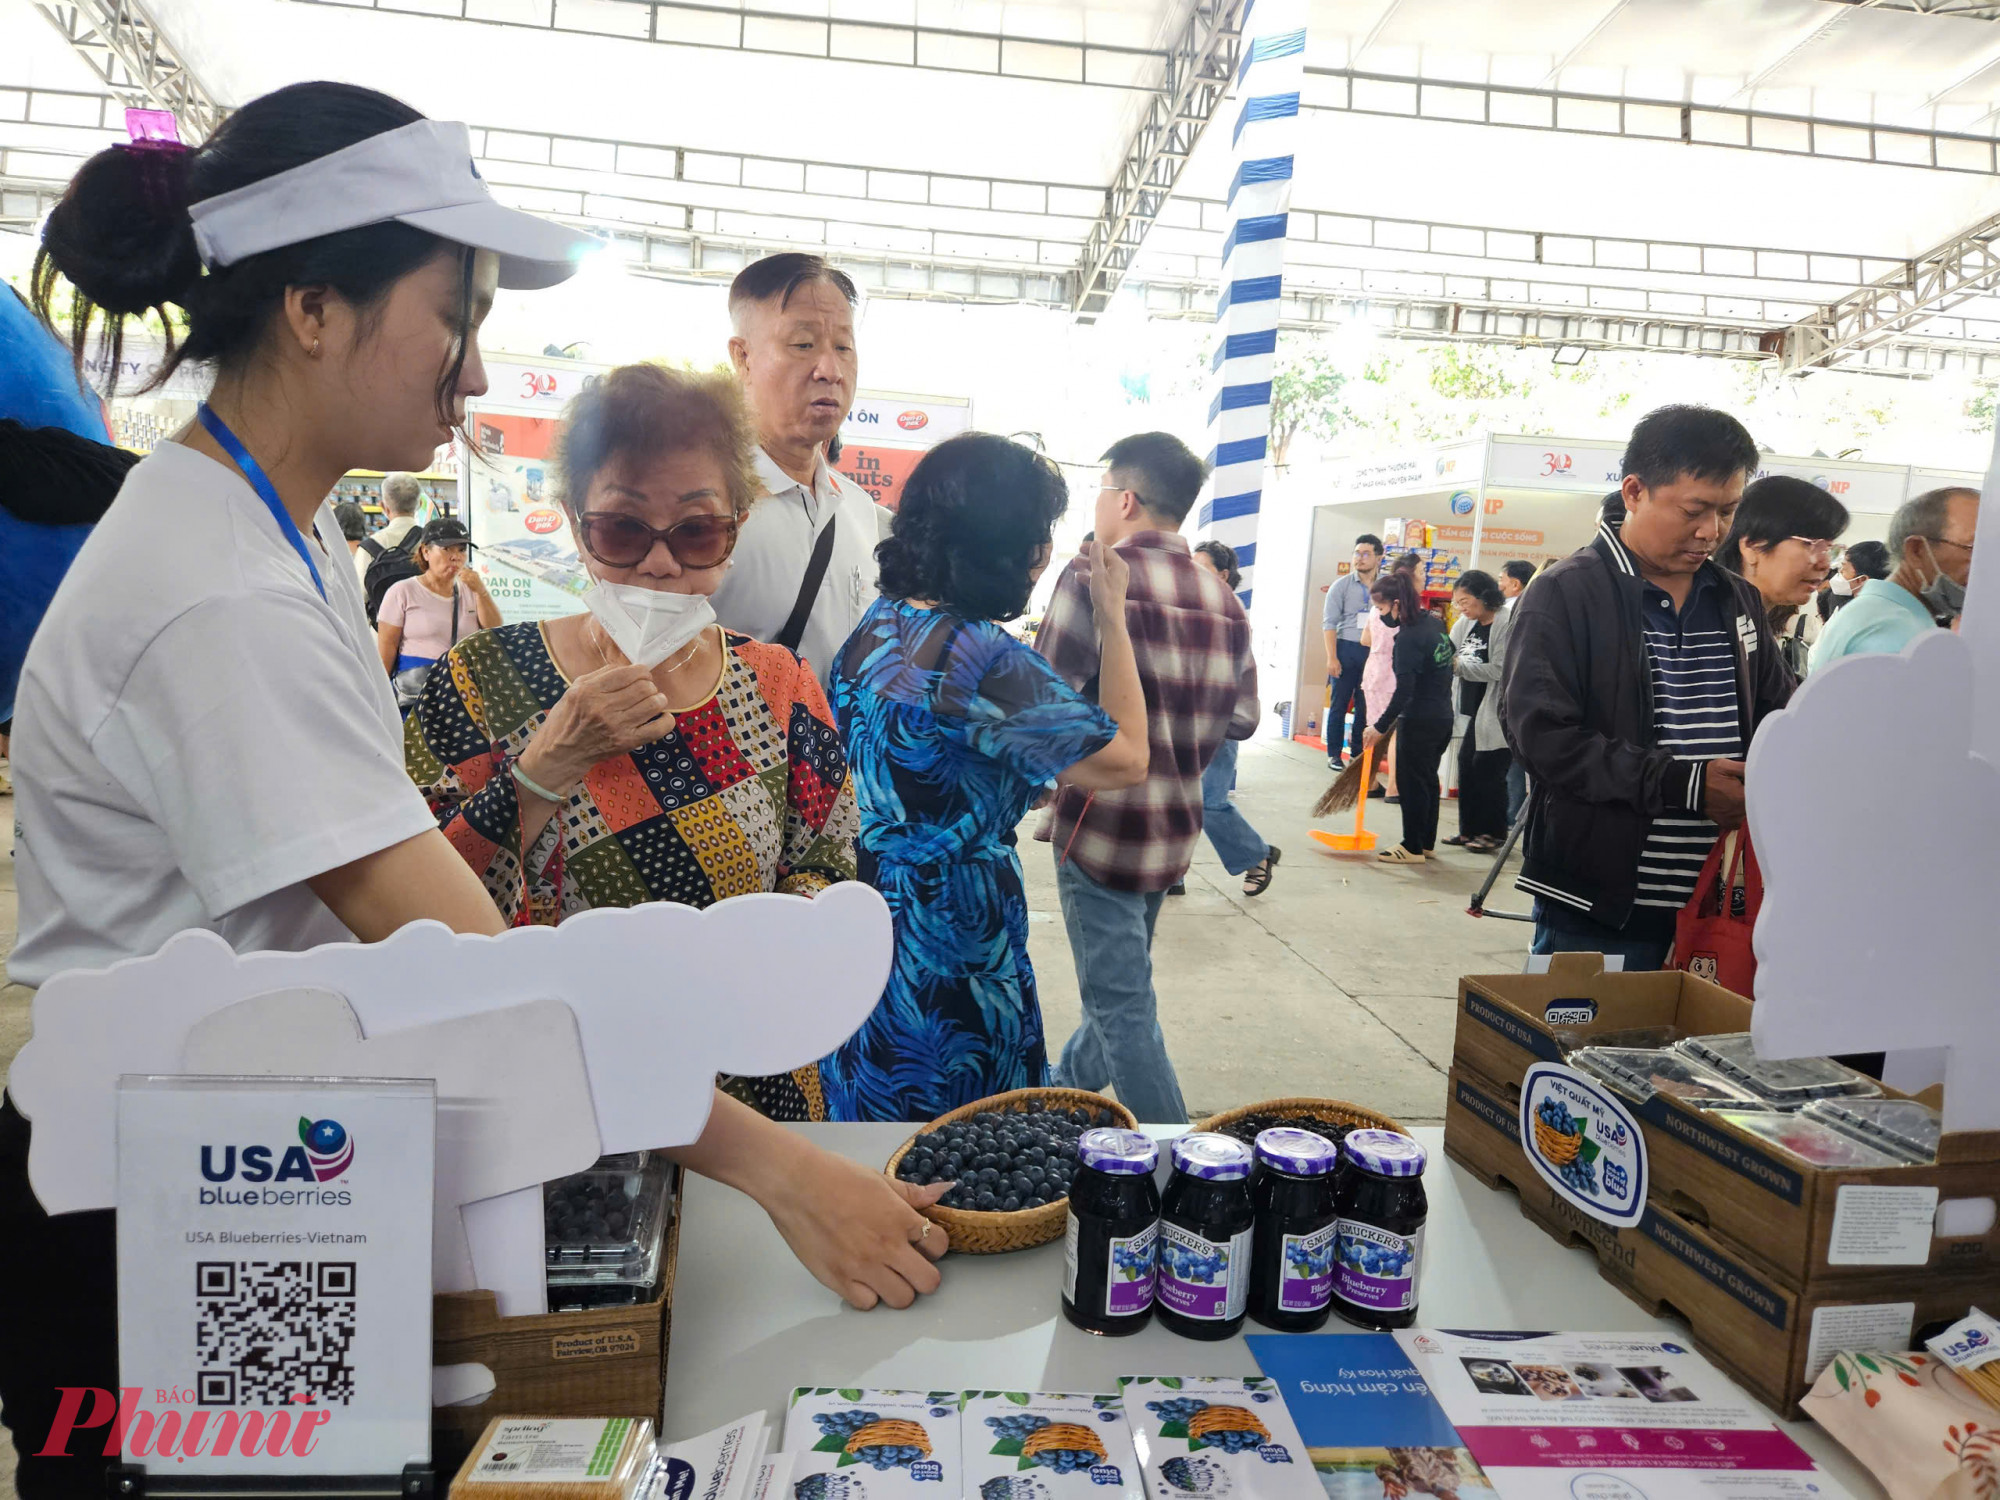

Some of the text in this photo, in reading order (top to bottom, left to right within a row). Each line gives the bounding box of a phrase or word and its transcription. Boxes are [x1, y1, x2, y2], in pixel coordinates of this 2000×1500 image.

[857, 409, 879, 424] ÔN
[856, 450, 880, 469] in
[1605, 472, 1622, 482] XU
[1829, 480, 1850, 494] NP
[512, 577, 532, 588] ON
[489, 588, 532, 598] OODS
[1470, 1001, 1533, 1046] PRODUCT OF USA
[1550, 1079, 1568, 1096] VIỆT
[1568, 1091, 1591, 1110] QUẤT
[1460, 1090, 1495, 1120] PRODUCT
[1495, 1113, 1506, 1126] OF
[1596, 1119, 1619, 1145] USA
[1665, 1112, 1792, 1192] NORTHWEST GROWN
[200, 1144, 317, 1183] USA
[1605, 1174, 1625, 1196] blue
[200, 1186, 352, 1207] blueberries
[185, 1231, 367, 1245] USA Blueberries-Vietnam
[1161, 1224, 1211, 1255] MUCKER'S
[1340, 1223, 1400, 1249] SMUCKER'S
[1654, 1223, 1776, 1315] NORTHWEST GROWN
[1341, 1272, 1388, 1296] Blueberry
[1346, 1283, 1380, 1301] Preserves
[556, 1335, 635, 1348] Product of U.S.A.
[1942, 1337, 1982, 1357] USA
[1339, 1367, 1420, 1380] quất Hoa Kỳ
[1300, 1380, 1356, 1397] hứng
[1357, 1382, 1398, 1397] cảm
